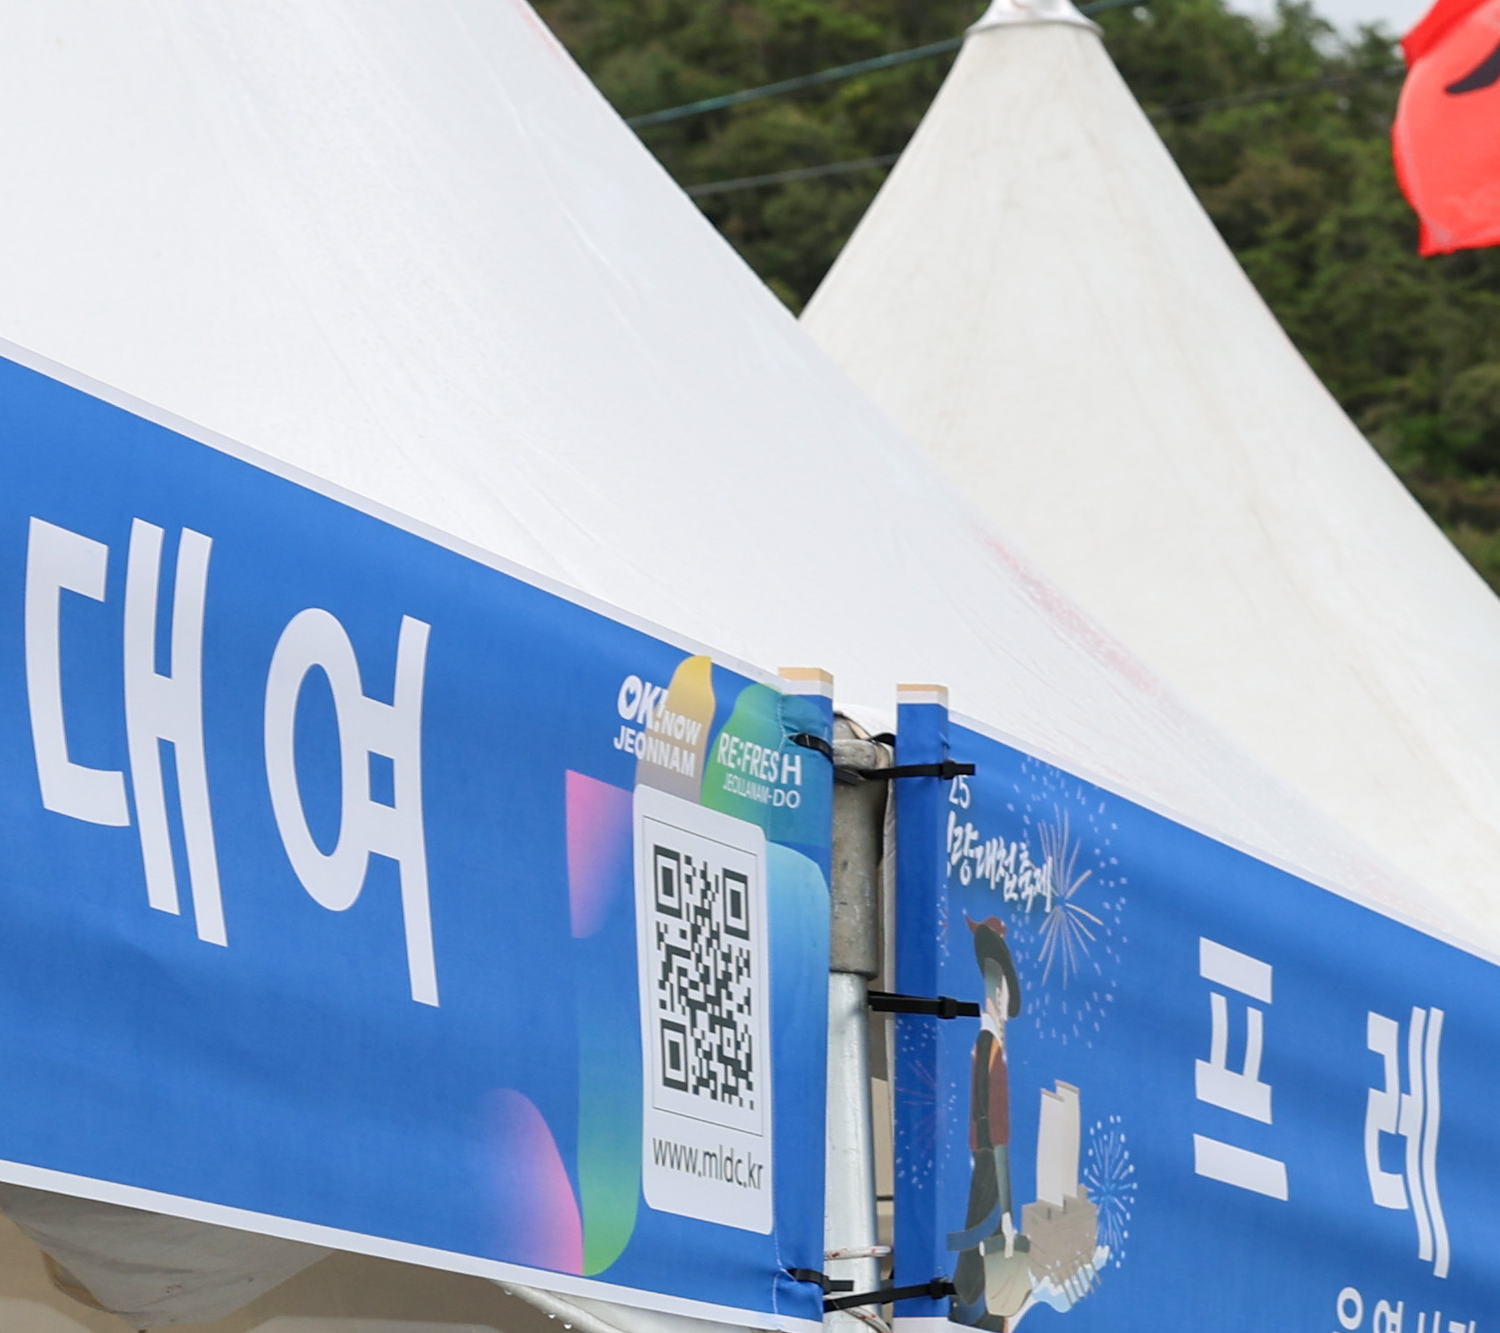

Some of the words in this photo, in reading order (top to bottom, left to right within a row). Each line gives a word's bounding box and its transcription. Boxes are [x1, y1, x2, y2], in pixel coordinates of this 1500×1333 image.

[613, 725, 696, 778] JEONNAM
[947, 810, 1053, 913] 량대첩축제
[653, 1137, 764, 1191] www.mldc.kr
